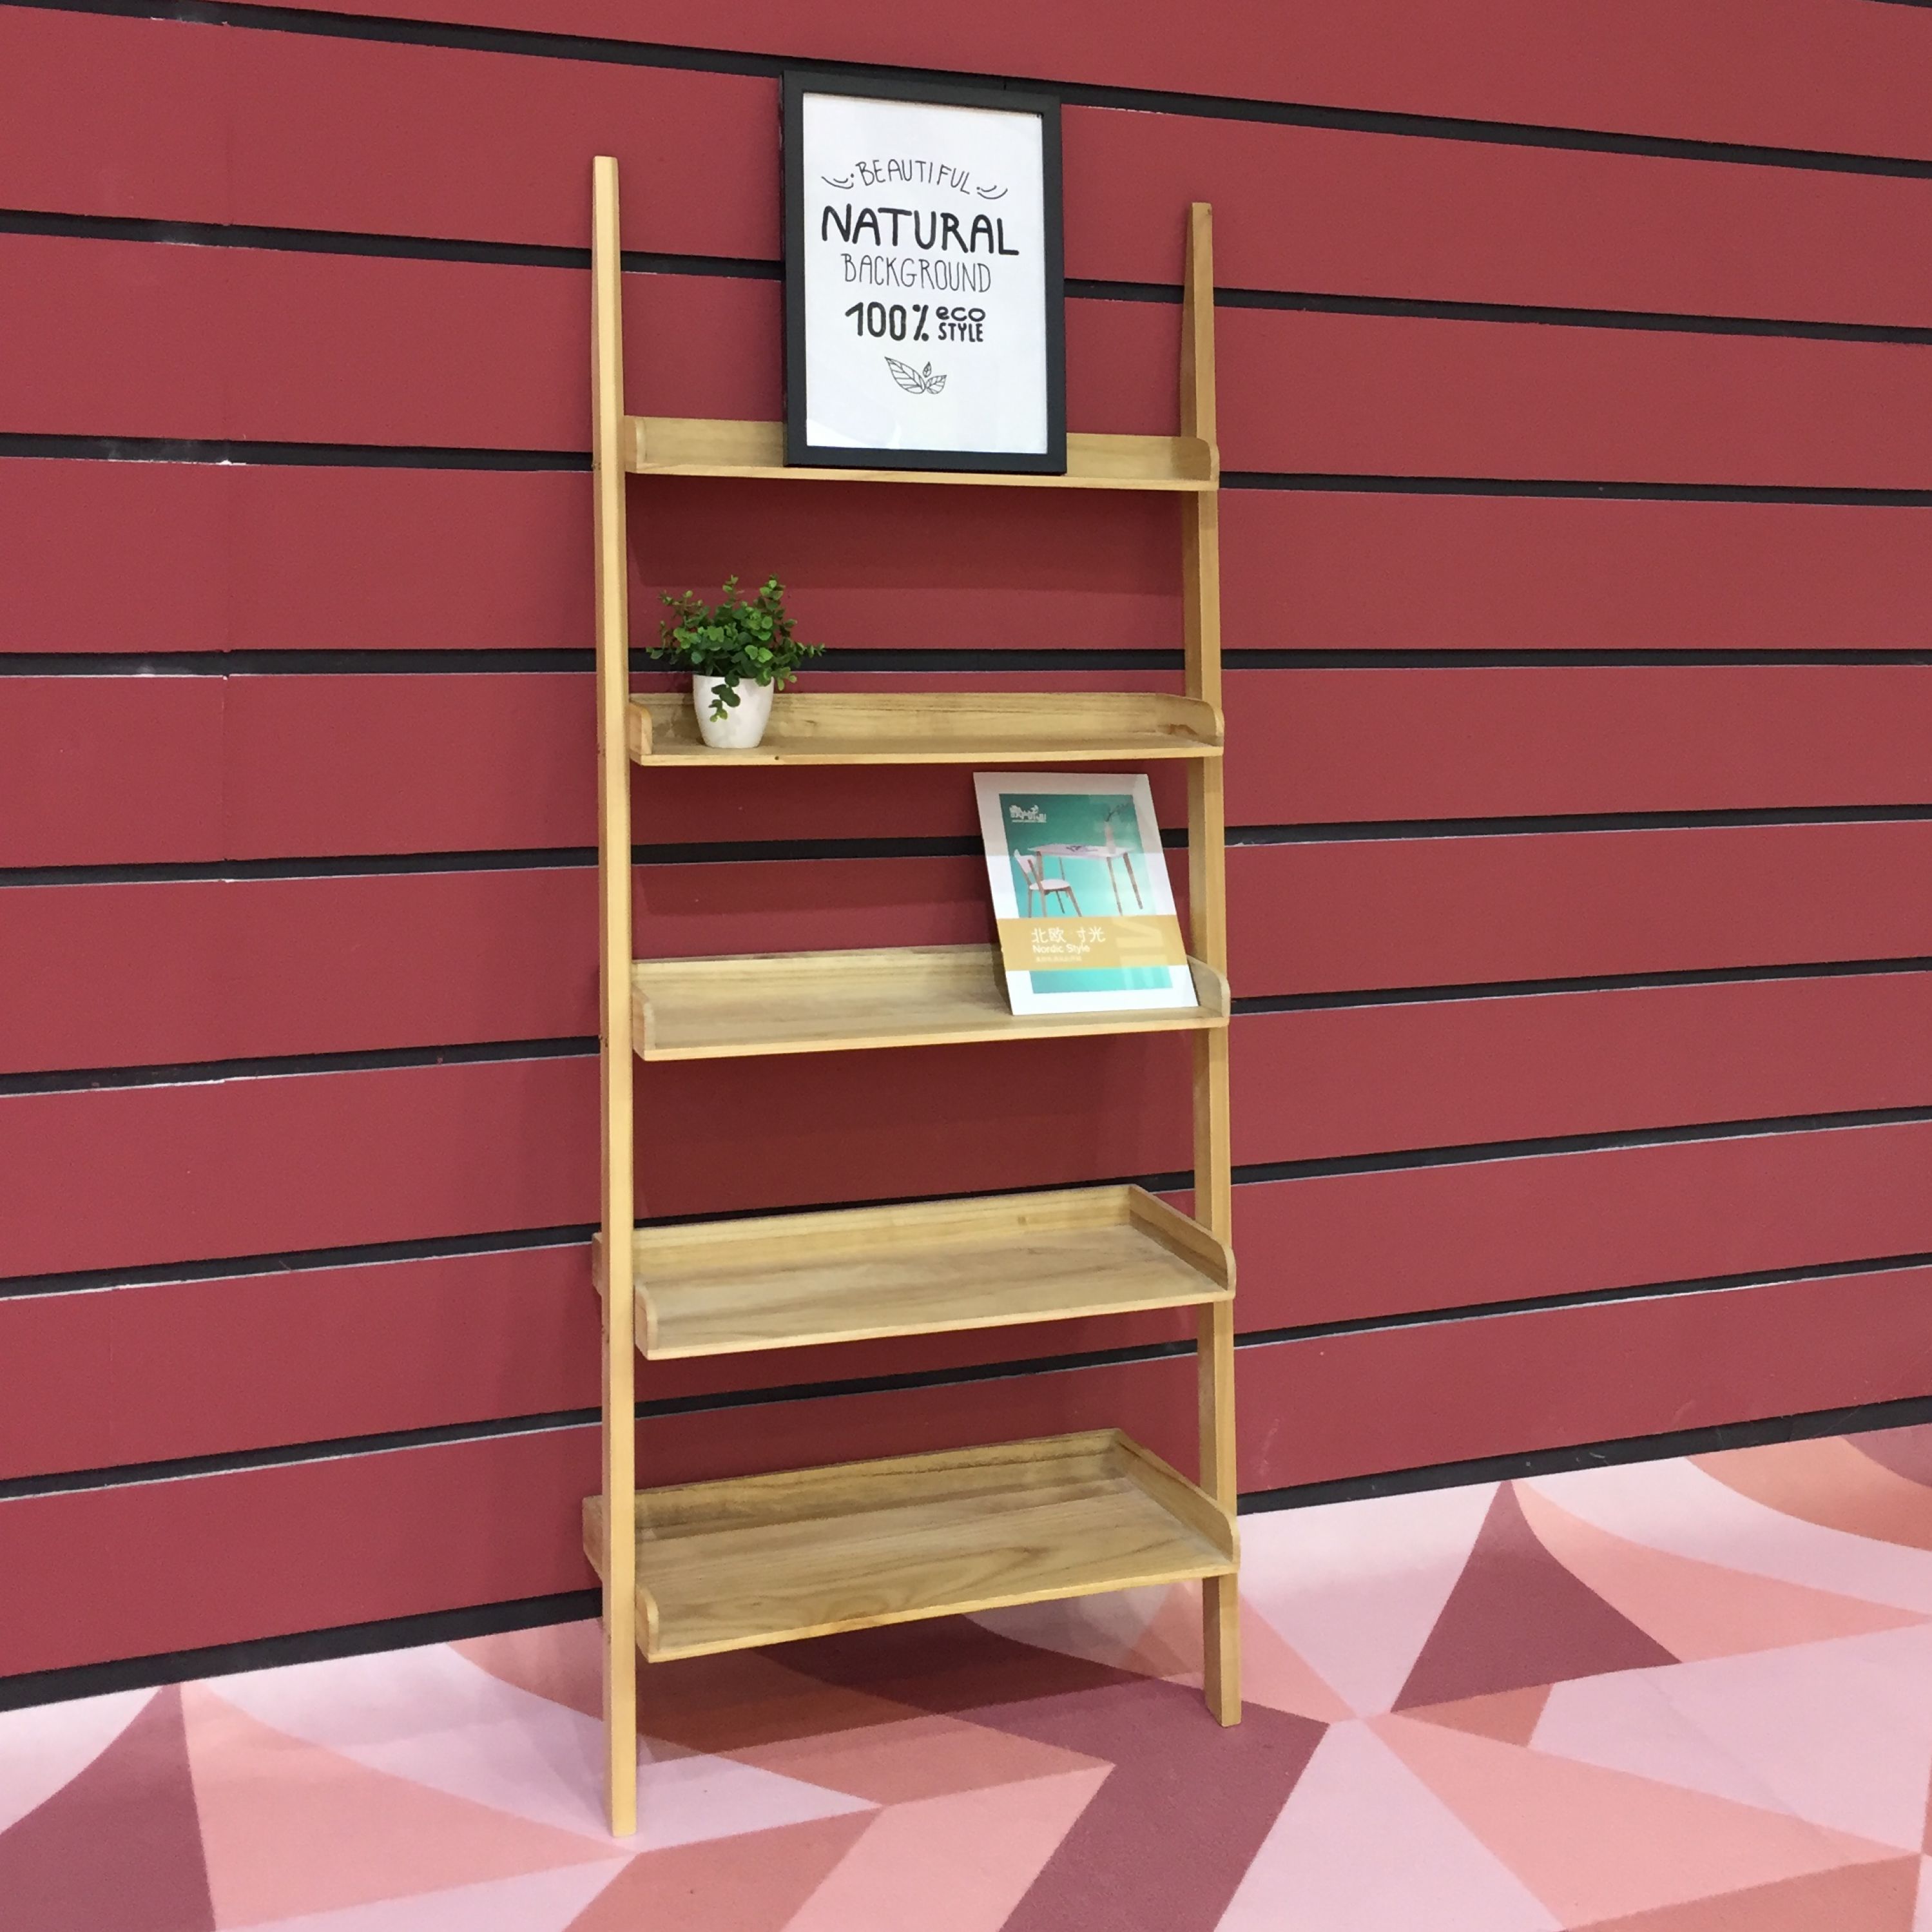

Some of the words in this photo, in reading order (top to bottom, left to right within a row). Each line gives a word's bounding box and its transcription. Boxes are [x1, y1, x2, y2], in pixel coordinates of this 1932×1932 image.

[855, 159, 971, 195] BEAUTIFUL
[822, 204, 1019, 255] NATURAL
[840, 253, 992, 293] BACKGROUND
[845, 302, 929, 342] 100%
[936, 306, 986, 322] eco
[938, 322, 983, 342] STYLE
[1032, 945, 1064, 953] Nordic
[1065, 942, 1090, 955] Style
